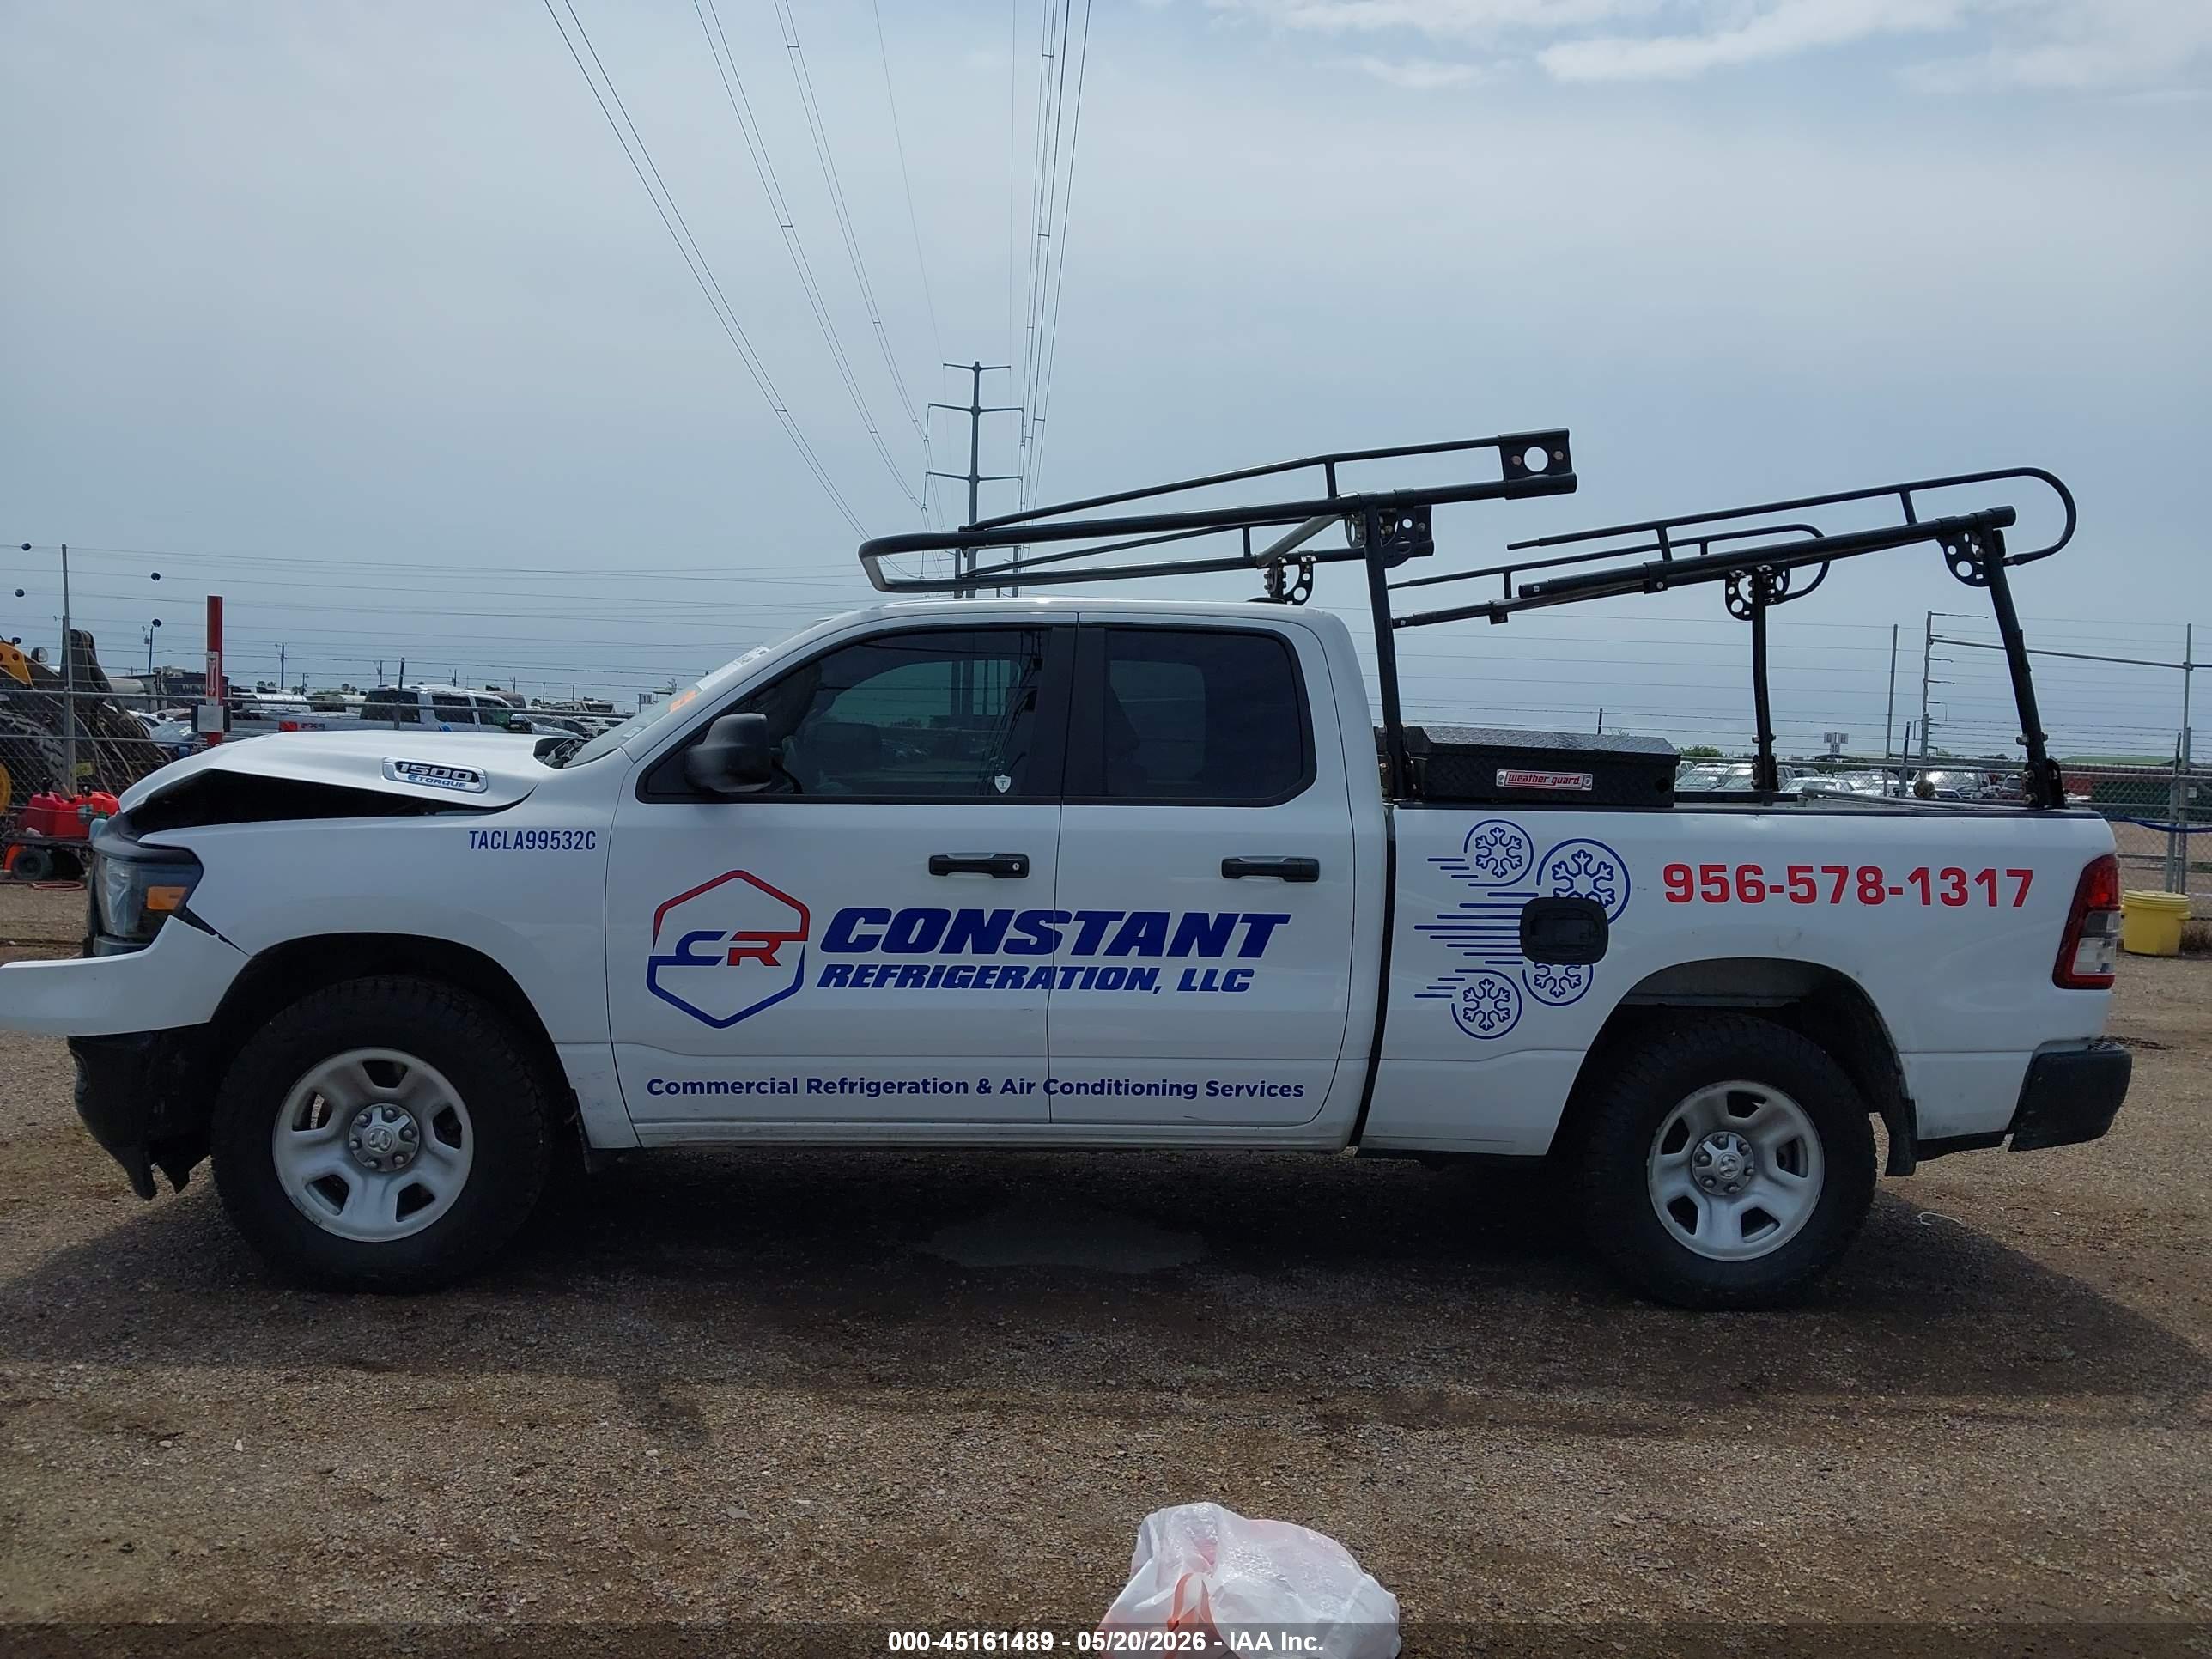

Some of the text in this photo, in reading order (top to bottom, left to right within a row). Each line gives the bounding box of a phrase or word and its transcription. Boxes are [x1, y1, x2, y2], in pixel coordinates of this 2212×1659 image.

[398, 763, 473, 781] 1500
[1509, 774, 1580, 786] weather guard
[469, 830, 598, 850] TACLA99532C
[1663, 864, 2033, 908] 956-578-1317
[820, 907, 1292, 958] CONSTANT
[816, 963, 1255, 995] REFRIGERATION, LLC
[647, 1078, 1304, 1099] Commercial Refrigeration & Air Conditioning Services
